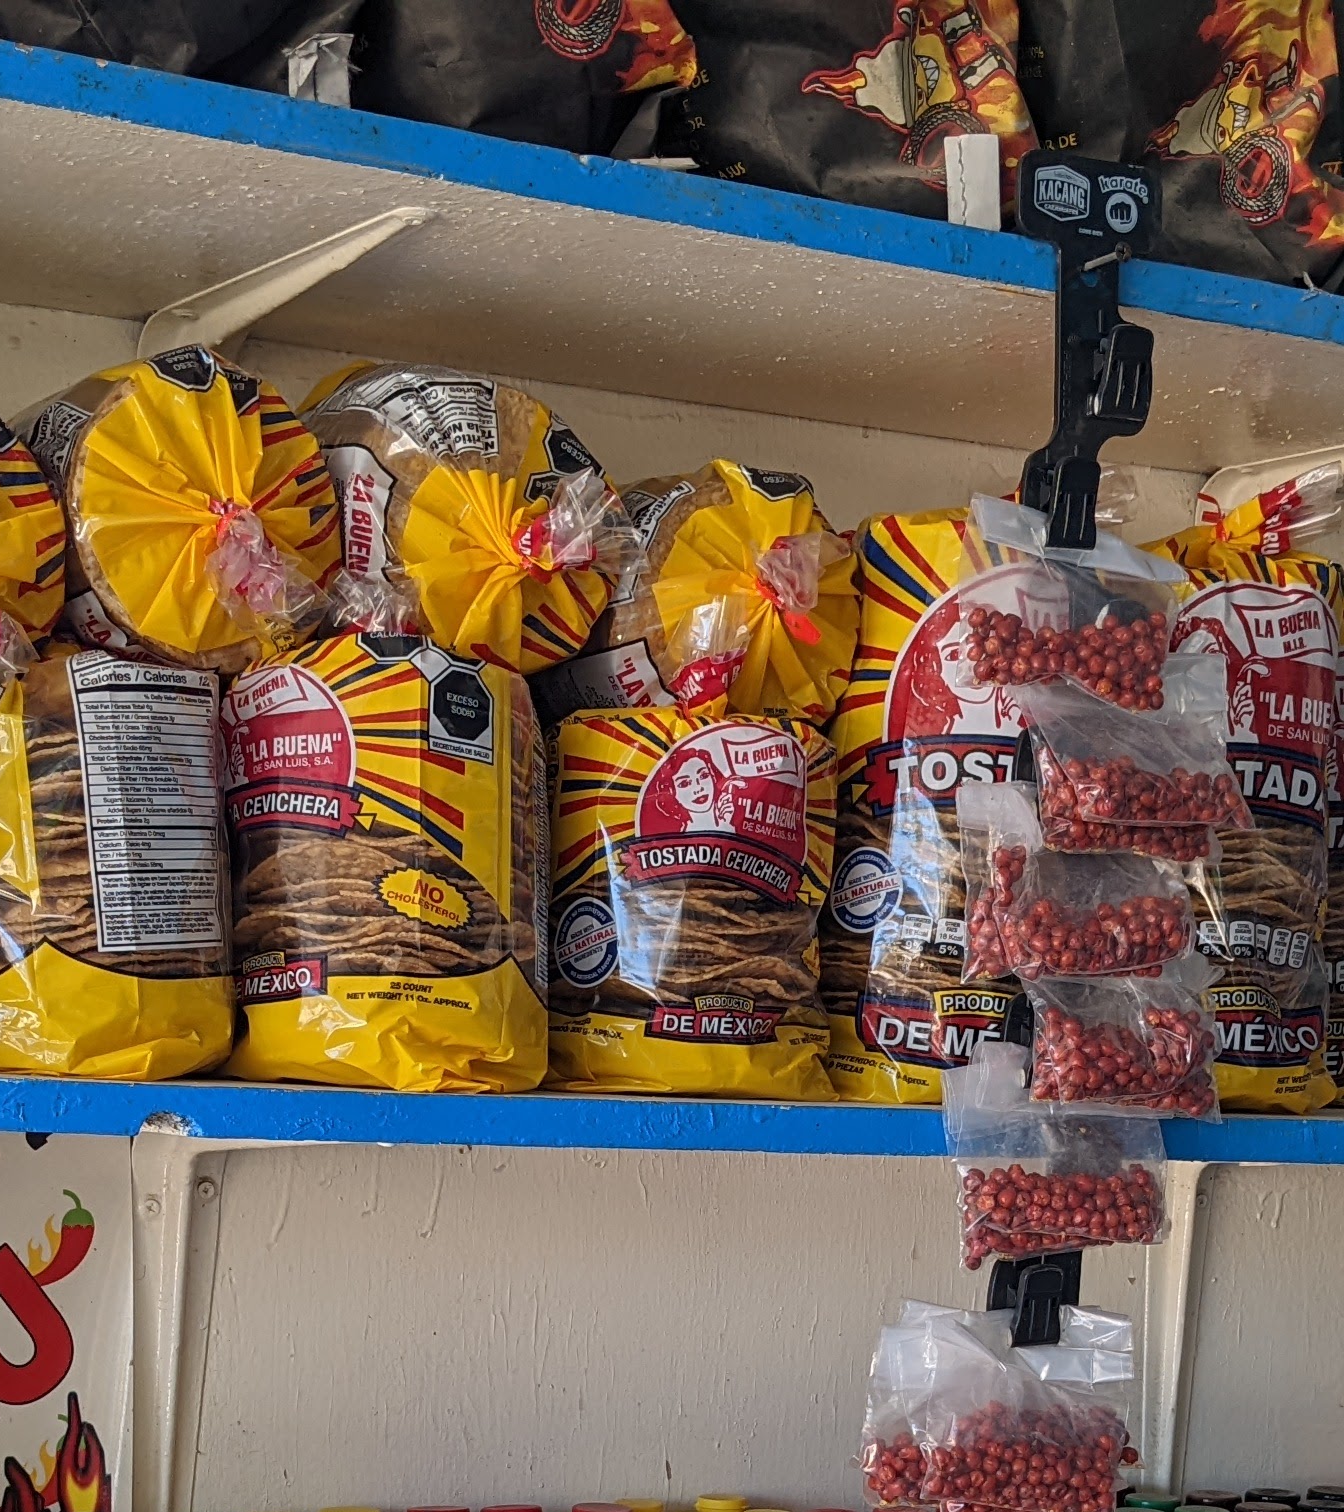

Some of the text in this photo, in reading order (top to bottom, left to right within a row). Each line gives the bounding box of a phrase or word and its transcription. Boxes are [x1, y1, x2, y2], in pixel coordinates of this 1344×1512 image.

[1039, 180, 1086, 209] KACANG
[1098, 175, 1148, 198] karate
[1254, 610, 1322, 639] LA BUENA
[1282, 637, 1308, 653] M.I.R.
[80, 671, 130, 688] Calories
[237, 674, 289, 708] LA BUENA
[446, 691, 479, 709] EXCESO
[1259, 690, 1298, 725] "LA
[1268, 724, 1311, 742] DE SAN
[246, 733, 342, 762] "LA BUENA"
[734, 743, 790, 765] LA BUENA
[264, 760, 282, 771] SAN
[286, 758, 311, 768] LUIS,
[314, 757, 333, 765] S.A.
[243, 793, 338, 818] CEVICHERA
[737, 798, 765, 820] "LA
[742, 820, 771, 835] DE SAN
[637, 845, 793, 894] TOSTADA CEVICHERA
[413, 879, 445, 904] NO
[833, 877, 899, 905] ALL NATURAL
[833, 877, 899, 905] ALL NATURAL
[386, 889, 462, 923] CHOLESTEROL
[572, 926, 616, 956] NATURAL
[245, 967, 312, 996] MÉXICO
[346, 992, 473, 1011] NET WEIGHT APPROX.
[699, 998, 752, 1011] PRODUCTO
[663, 1012, 773, 1036] DE MÉXICO
[877, 1017, 927, 1053] DE
[1220, 1022, 1318, 1054] MÉXICO
